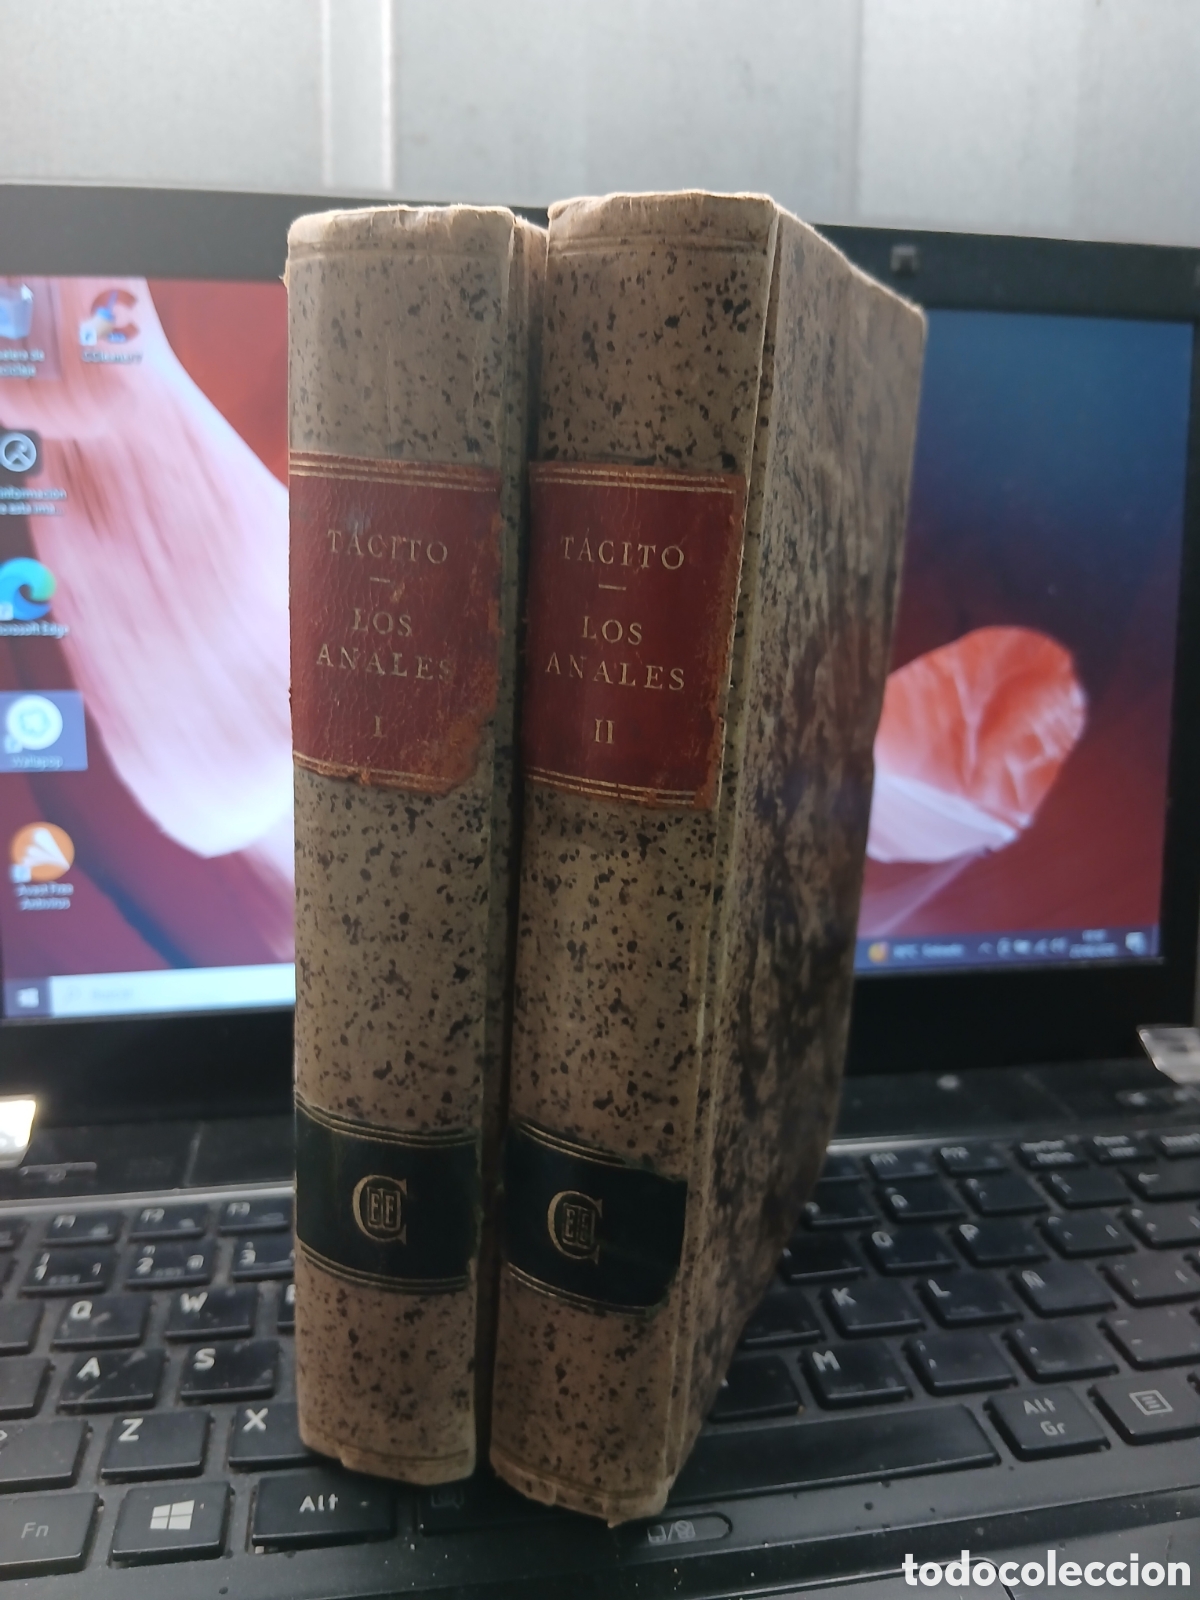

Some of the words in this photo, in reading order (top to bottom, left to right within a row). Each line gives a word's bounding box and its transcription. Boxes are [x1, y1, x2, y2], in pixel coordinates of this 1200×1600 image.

[561, 527, 685, 570] TÁCITO
[352, 607, 412, 637] LOS
[582, 615, 643, 646] LOS
[316, 643, 453, 682] ANALES
[545, 652, 685, 691] ANALES
[594, 718, 615, 744] II
[180, 1291, 208, 1313] W
[831, 1287, 857, 1306] K
[70, 1300, 93, 1321] Q
[76, 1357, 101, 1380] A
[193, 1348, 216, 1371] S
[812, 1350, 841, 1371] M
[1023, 1397, 1056, 1415] Alt
[118, 1418, 144, 1442] Z
[243, 1407, 268, 1433] X
[1040, 1420, 1066, 1436] Gr
[299, 1494, 339, 1513] Alt
[21, 1522, 49, 1538] Fn
